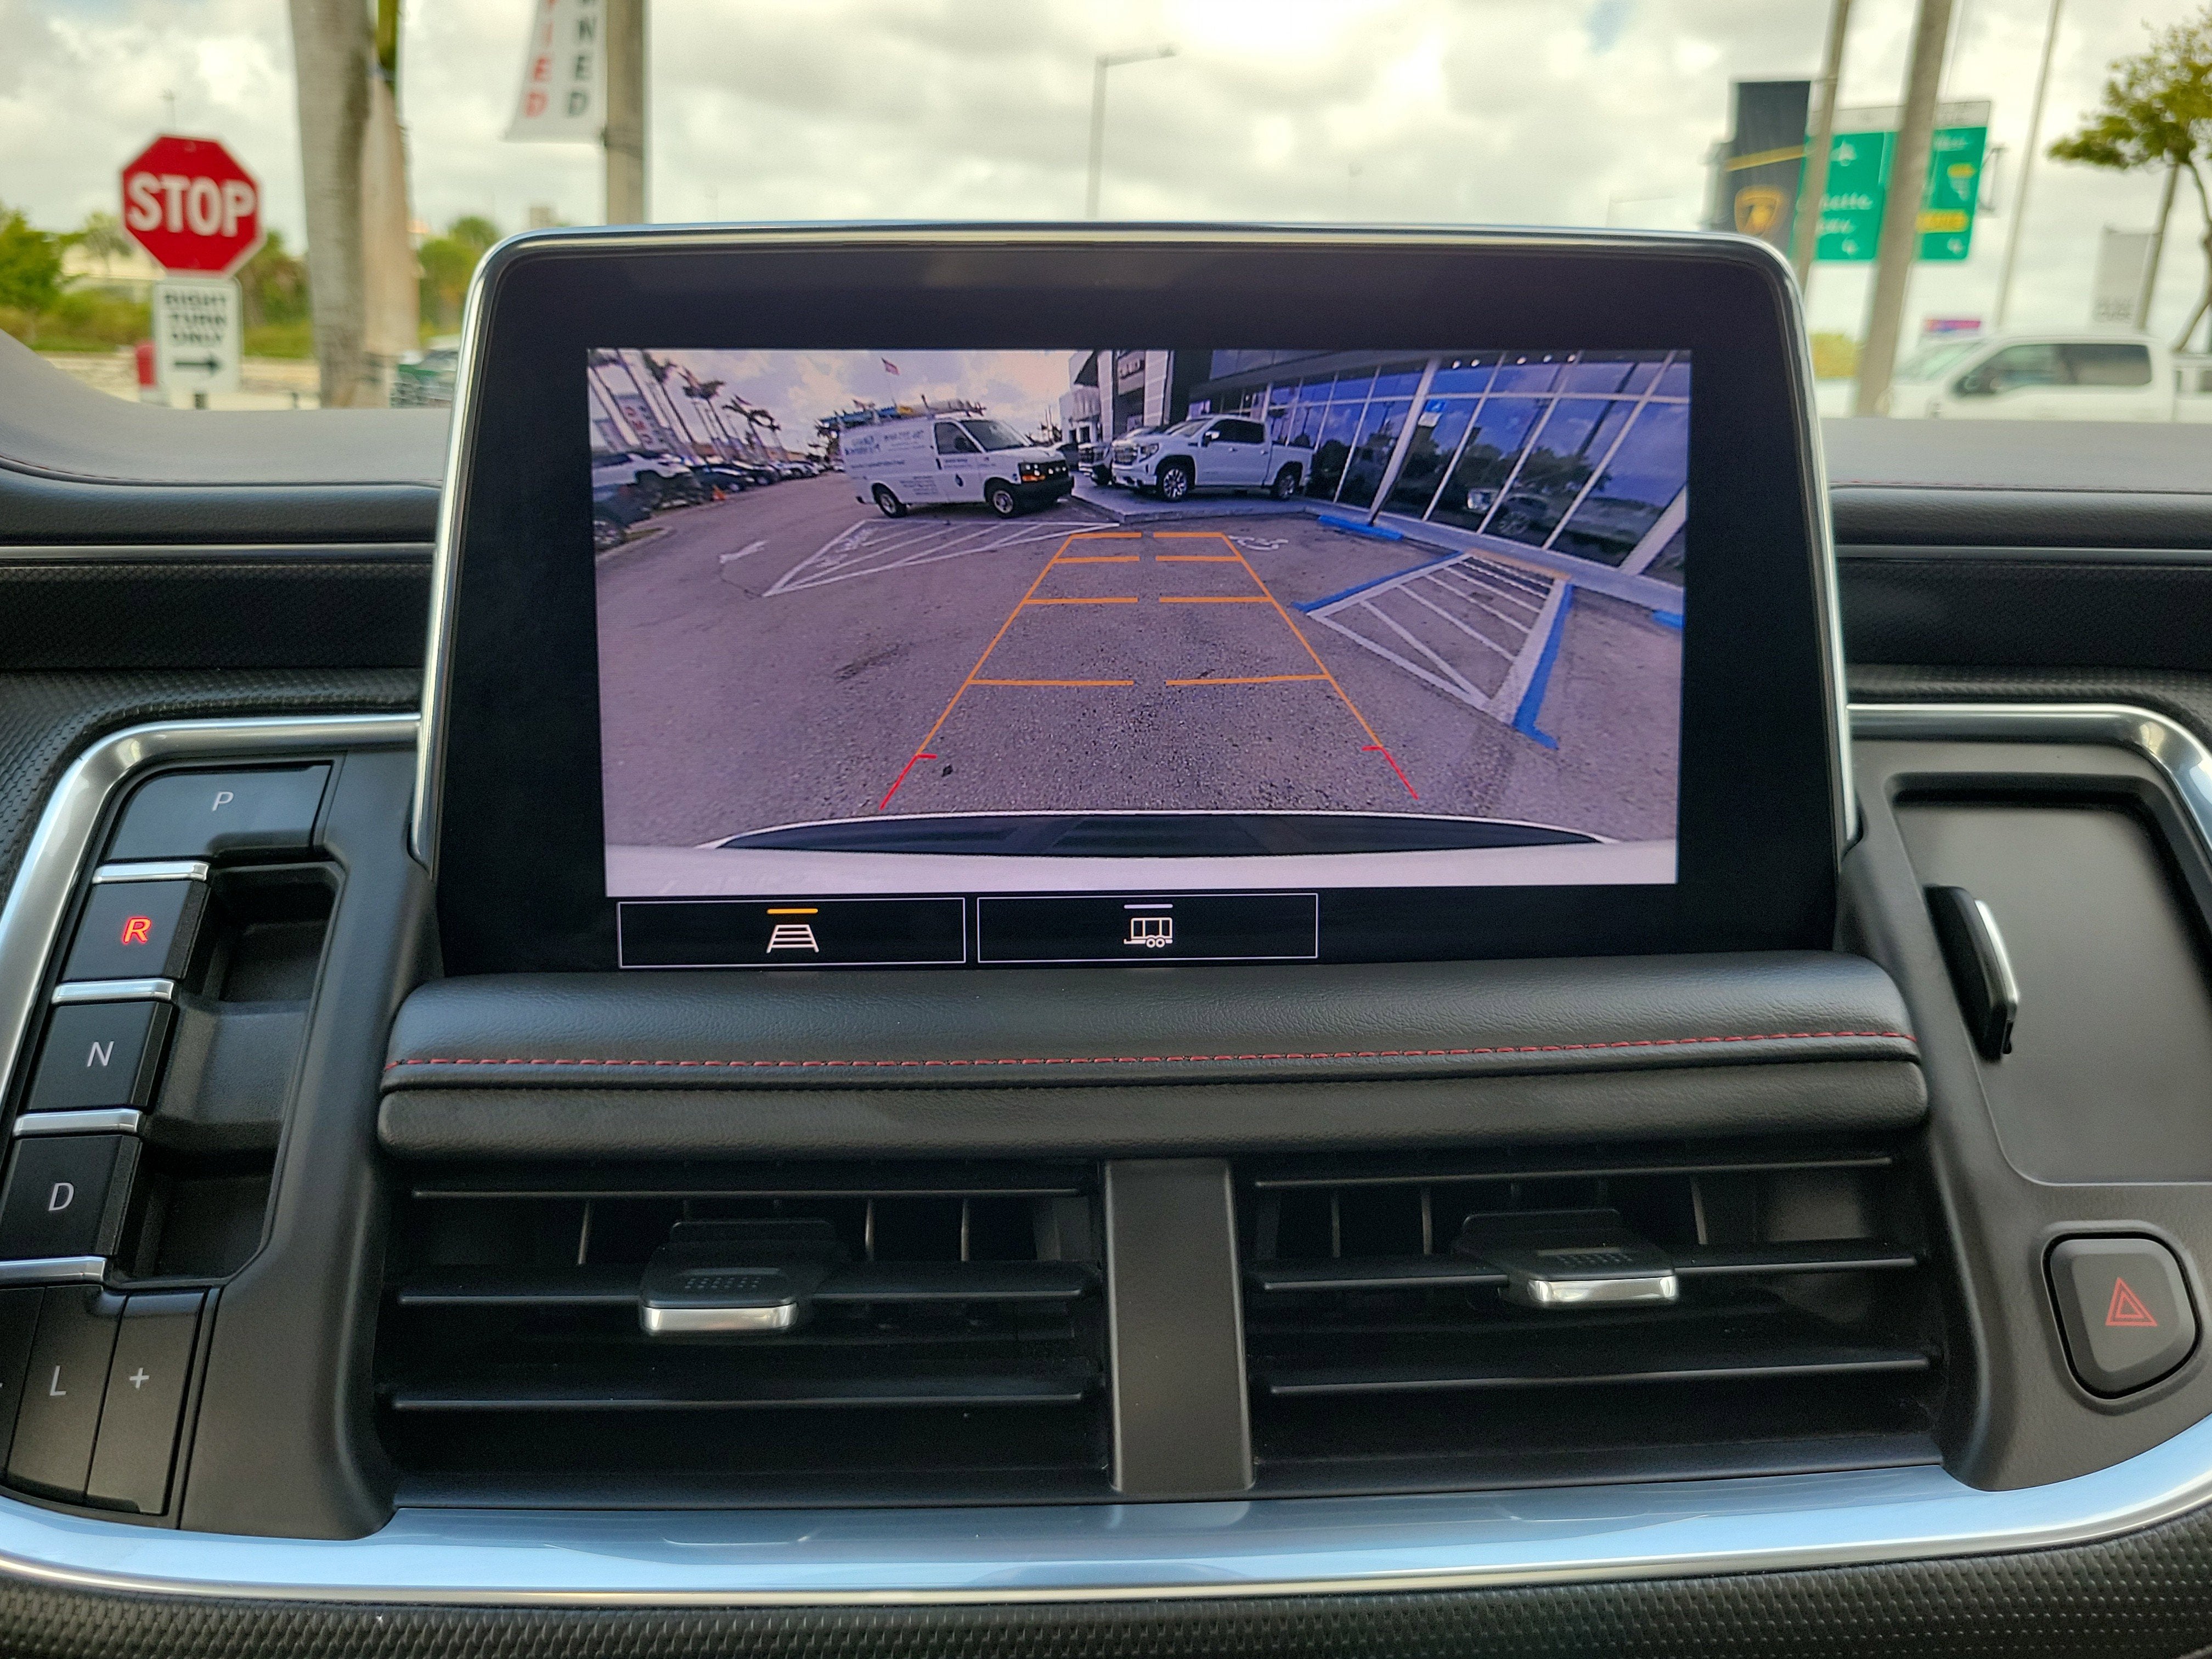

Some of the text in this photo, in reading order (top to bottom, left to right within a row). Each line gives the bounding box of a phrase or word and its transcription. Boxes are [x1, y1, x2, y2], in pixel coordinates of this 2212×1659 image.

[523, 0, 556, 119] IED
[566, 0, 597, 117] NED
[127, 171, 256, 237] STOP
[165, 292, 227, 307] RIGHT
[169, 313, 227, 326] TURN
[172, 331, 223, 345] ONLY
[212, 791, 234, 811] P
[123, 917, 151, 944] R
[87, 1041, 115, 1067] N
[48, 1182, 75, 1212] D
[49, 1365, 66, 1396] L
